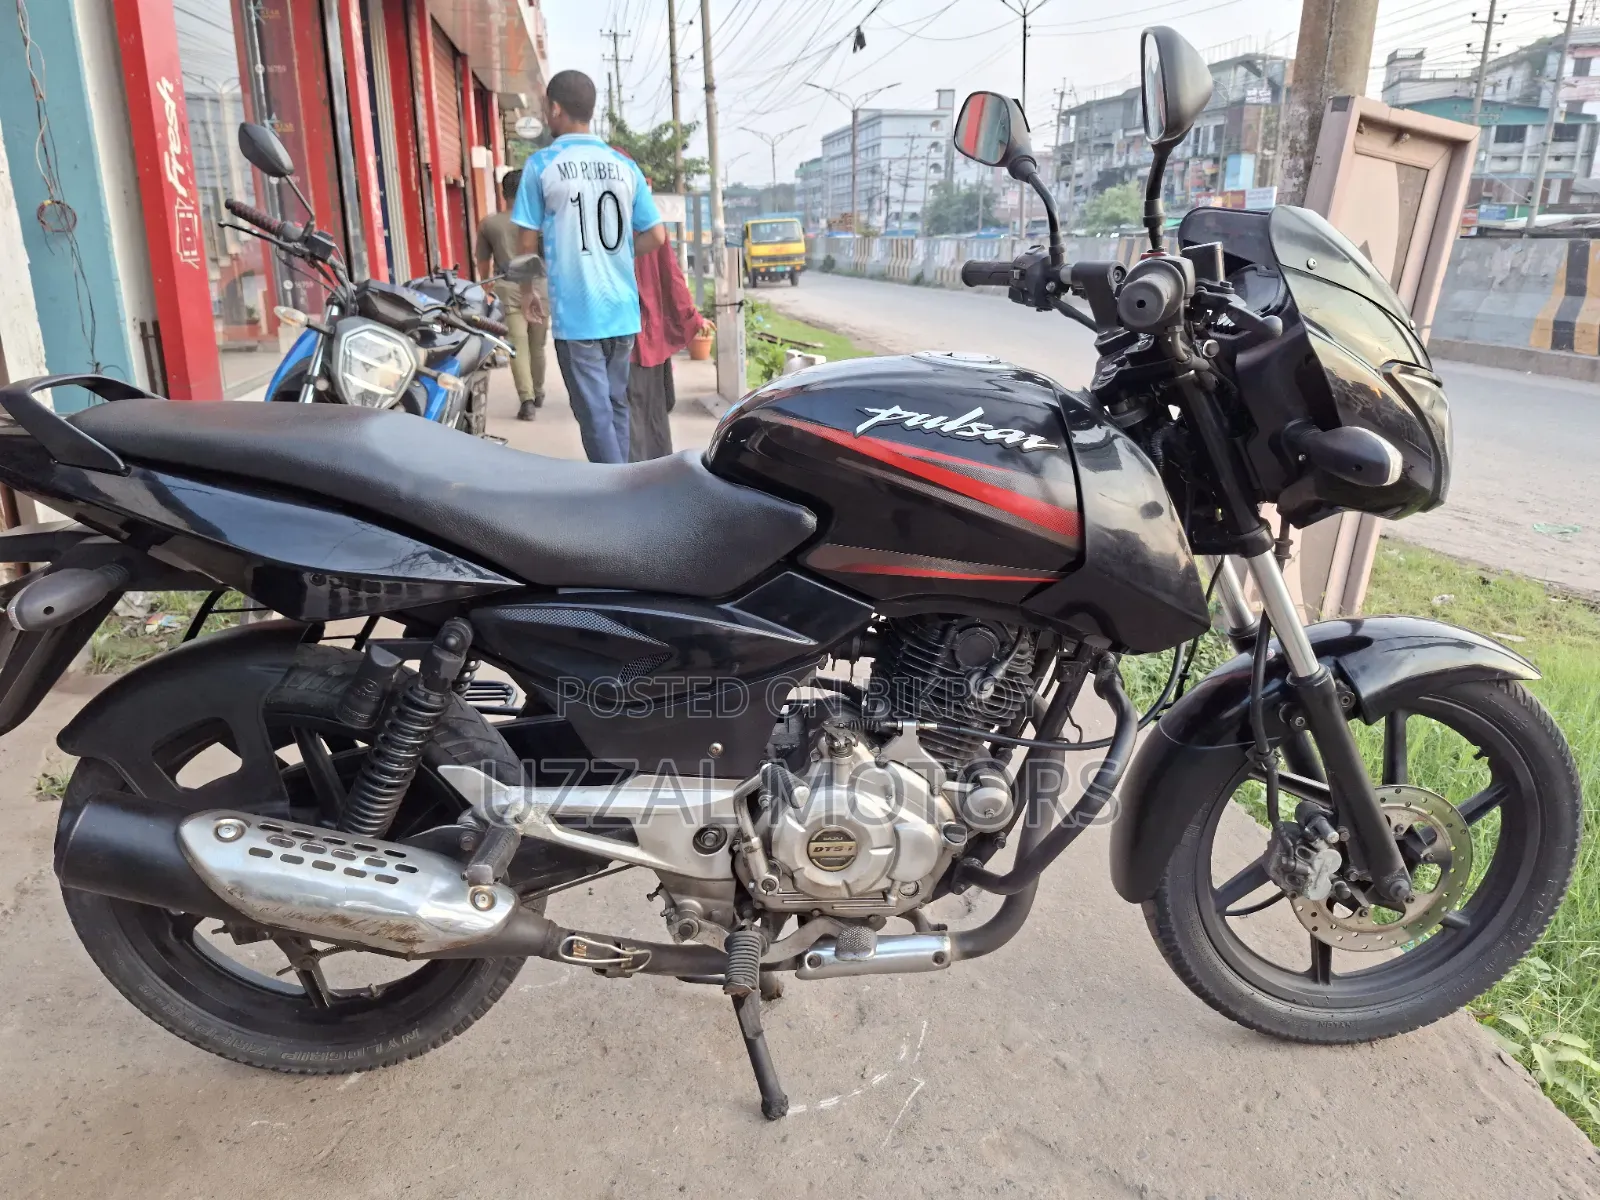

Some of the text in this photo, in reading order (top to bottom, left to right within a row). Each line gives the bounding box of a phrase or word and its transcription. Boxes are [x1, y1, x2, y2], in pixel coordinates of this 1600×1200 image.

[156, 76, 188, 198] Fresh
[556, 161, 624, 182] MD RUBEL
[570, 190, 626, 256] 10
